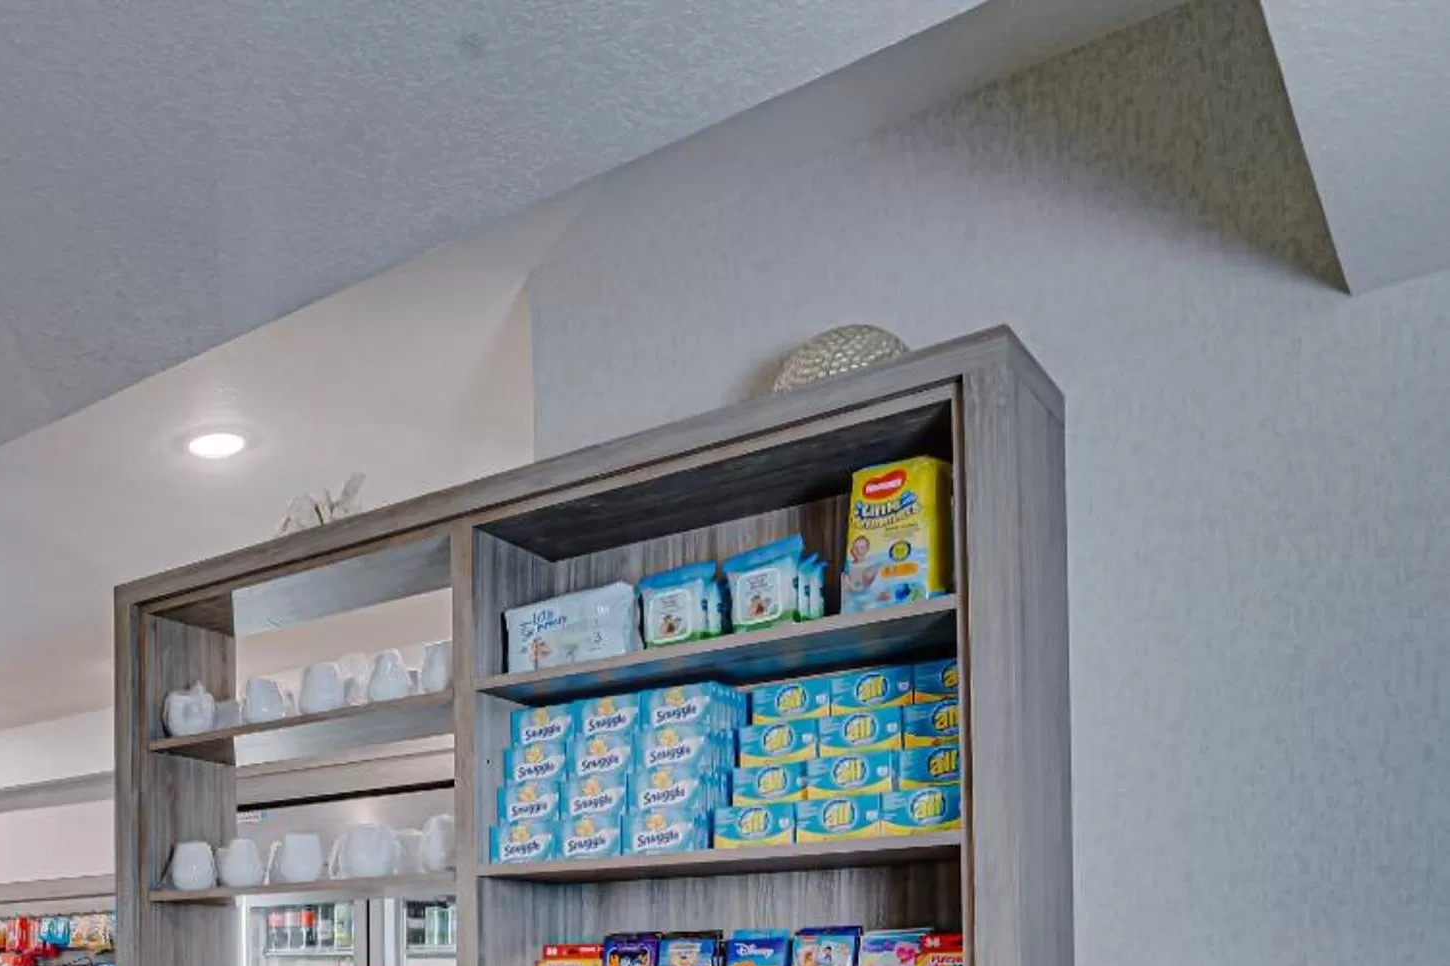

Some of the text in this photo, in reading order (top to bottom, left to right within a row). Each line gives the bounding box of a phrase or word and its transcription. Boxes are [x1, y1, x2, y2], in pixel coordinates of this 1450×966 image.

[846, 716, 871, 741] all
[930, 751, 957, 777] all
[825, 802, 851, 827] all
[913, 793, 941, 819] all
[734, 943, 774, 959] Disney
